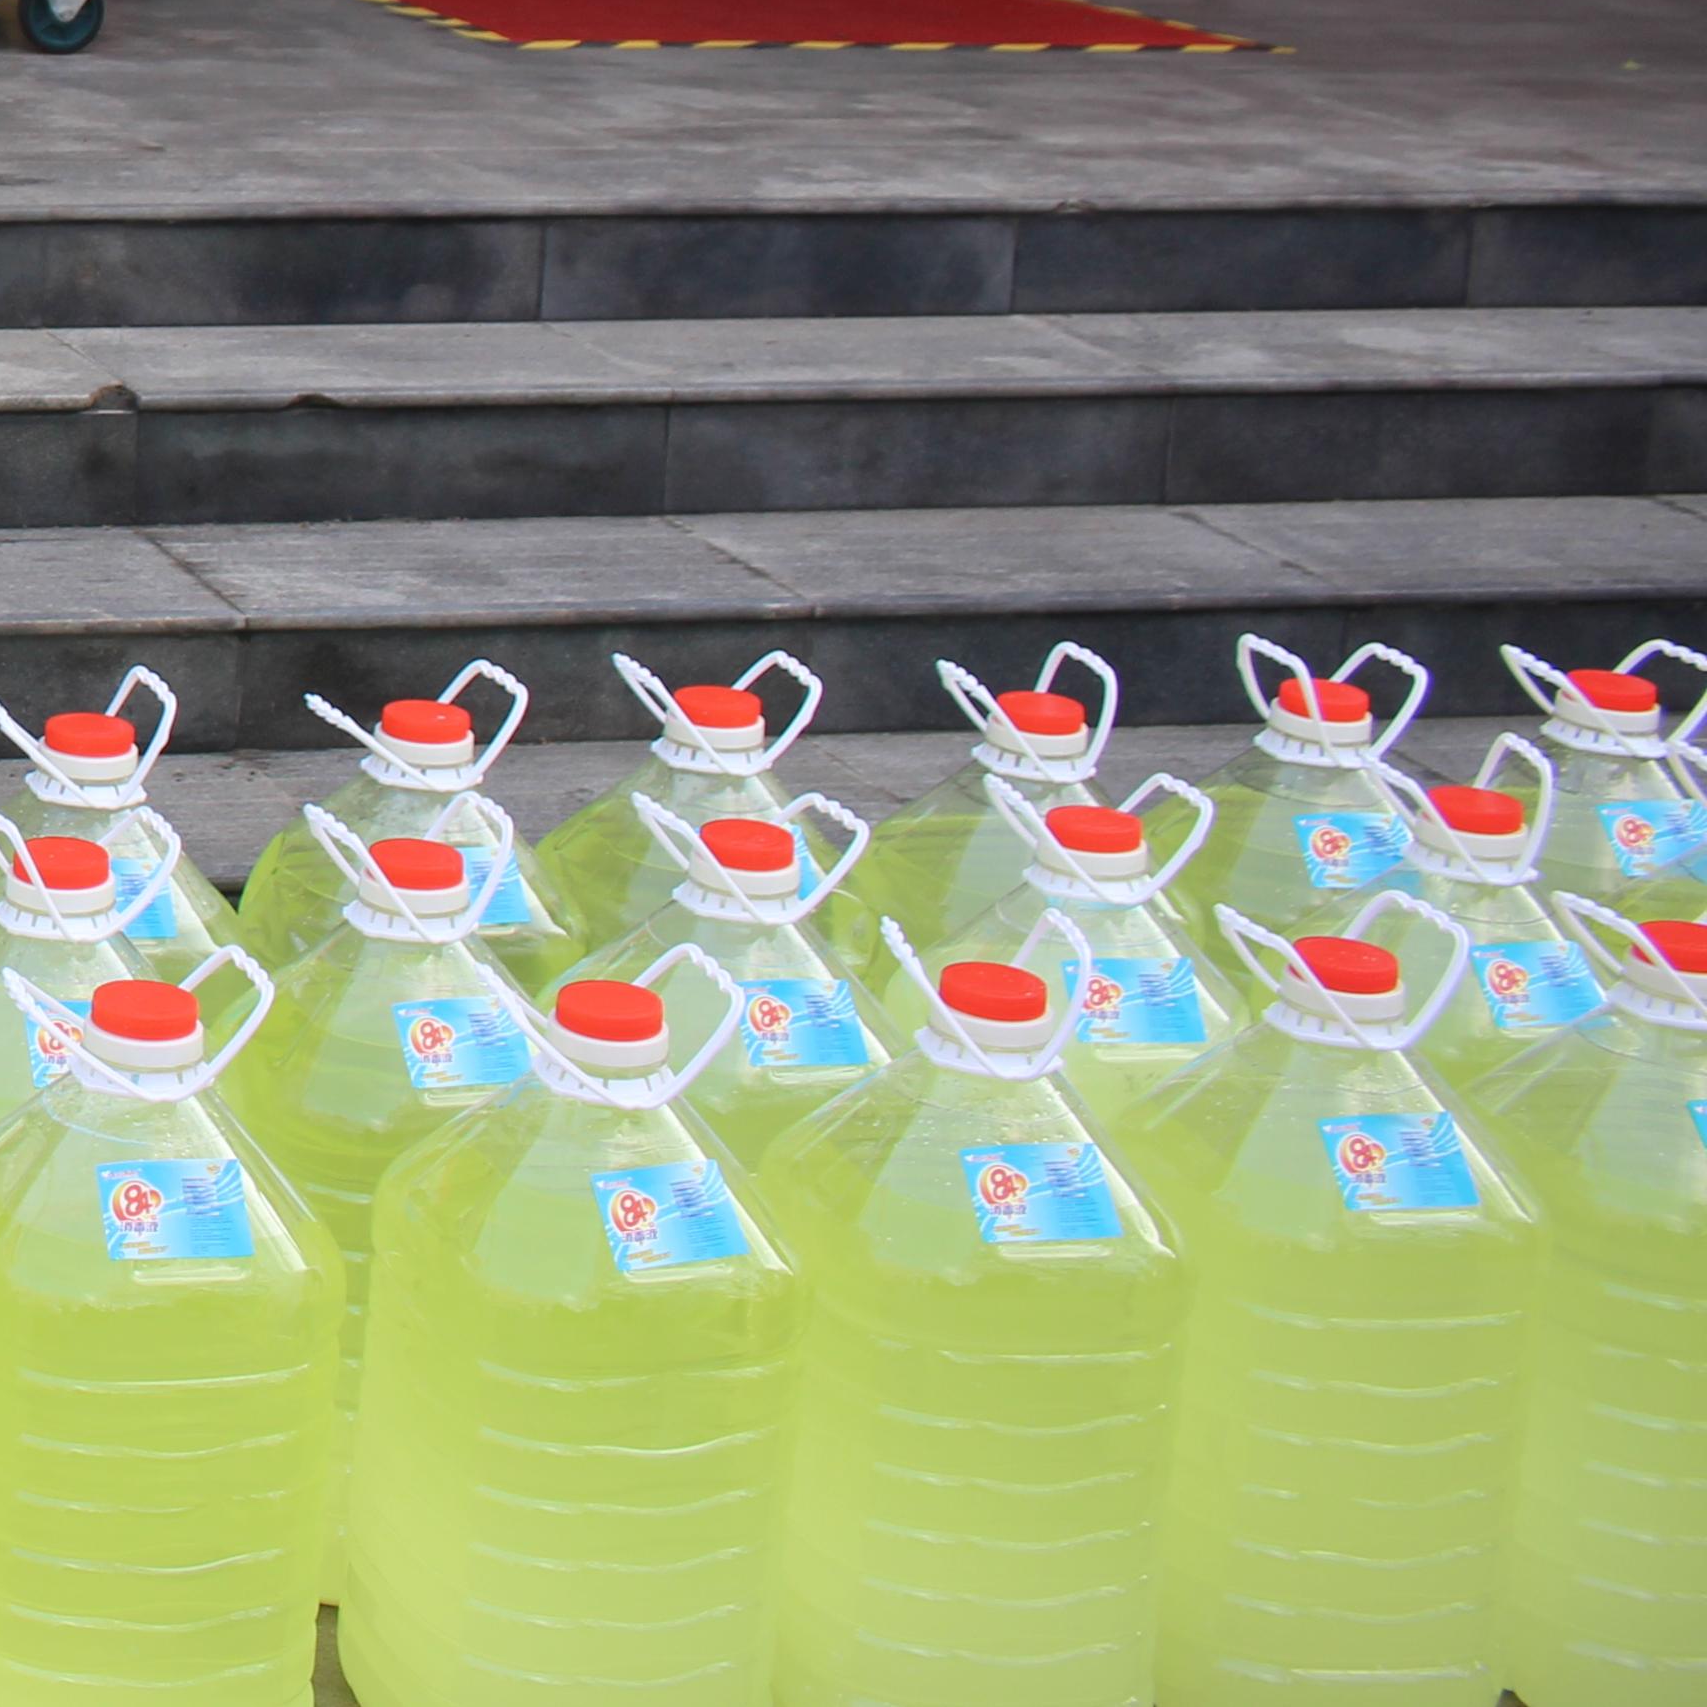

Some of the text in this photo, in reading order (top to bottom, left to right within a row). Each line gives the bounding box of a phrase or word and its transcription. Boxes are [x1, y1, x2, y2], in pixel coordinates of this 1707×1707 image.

[420, 1021, 446, 1048] 84
[1348, 1136, 1377, 1170] 84
[123, 1184, 152, 1217] 84
[989, 1168, 1018, 1202] 84
[619, 1192, 648, 1228] 84
